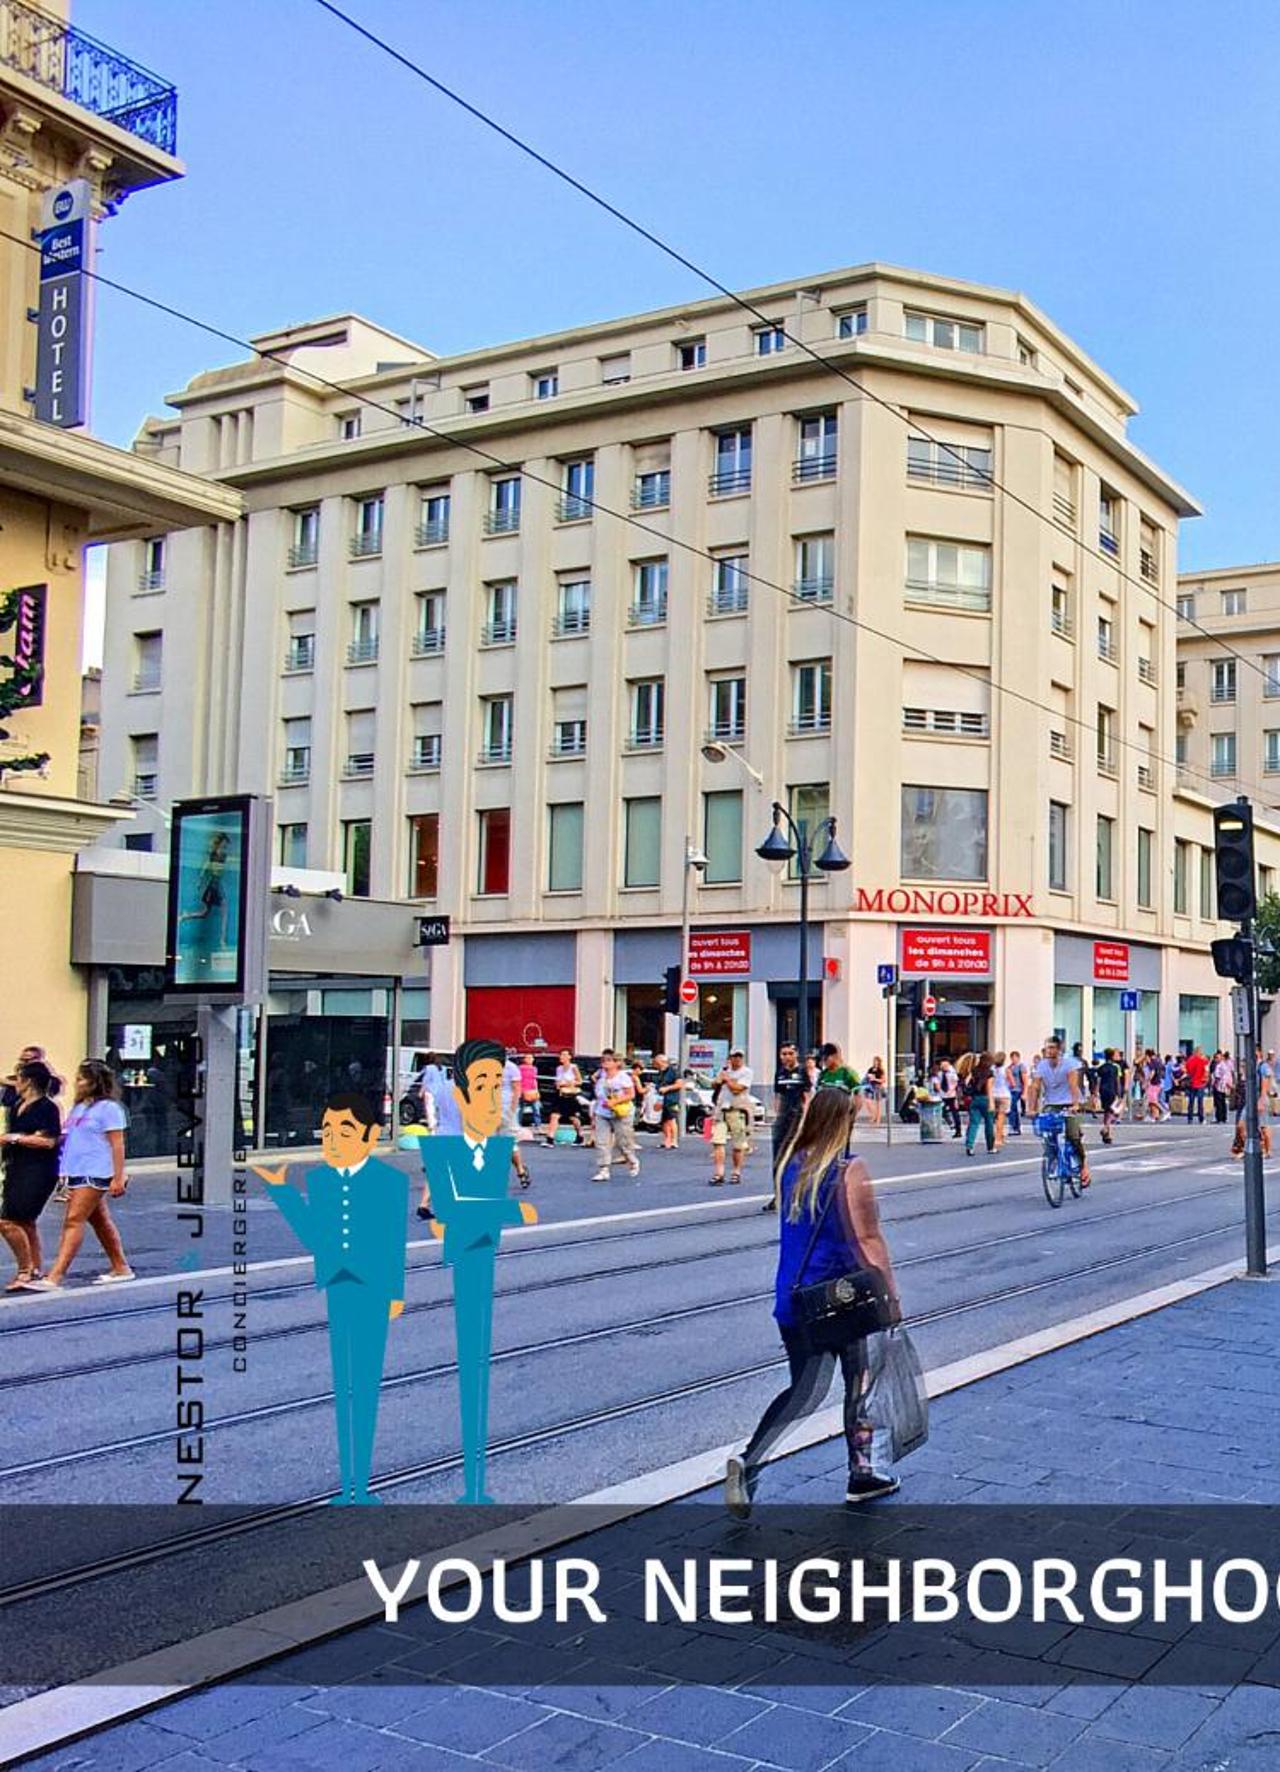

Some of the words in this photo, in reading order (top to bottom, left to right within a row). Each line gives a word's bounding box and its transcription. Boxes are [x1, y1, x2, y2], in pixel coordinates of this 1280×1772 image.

[51, 235, 72, 251] Best
[52, 286, 68, 420] HOTEL
[856, 888, 1034, 917] MONOPRIX
[691, 938, 719, 947] ouvert
[720, 938, 740, 946] tous
[916, 936, 951, 945] ouvert
[952, 936, 977, 945] tous
[699, 949, 746, 958] dimanches
[908, 946, 925, 956] les
[927, 947, 984, 957] dimanches
[914, 959, 929, 968] de
[931, 959, 946, 968] 9h
[947, 958, 955, 969] à
[957, 959, 988, 969] 20h30
